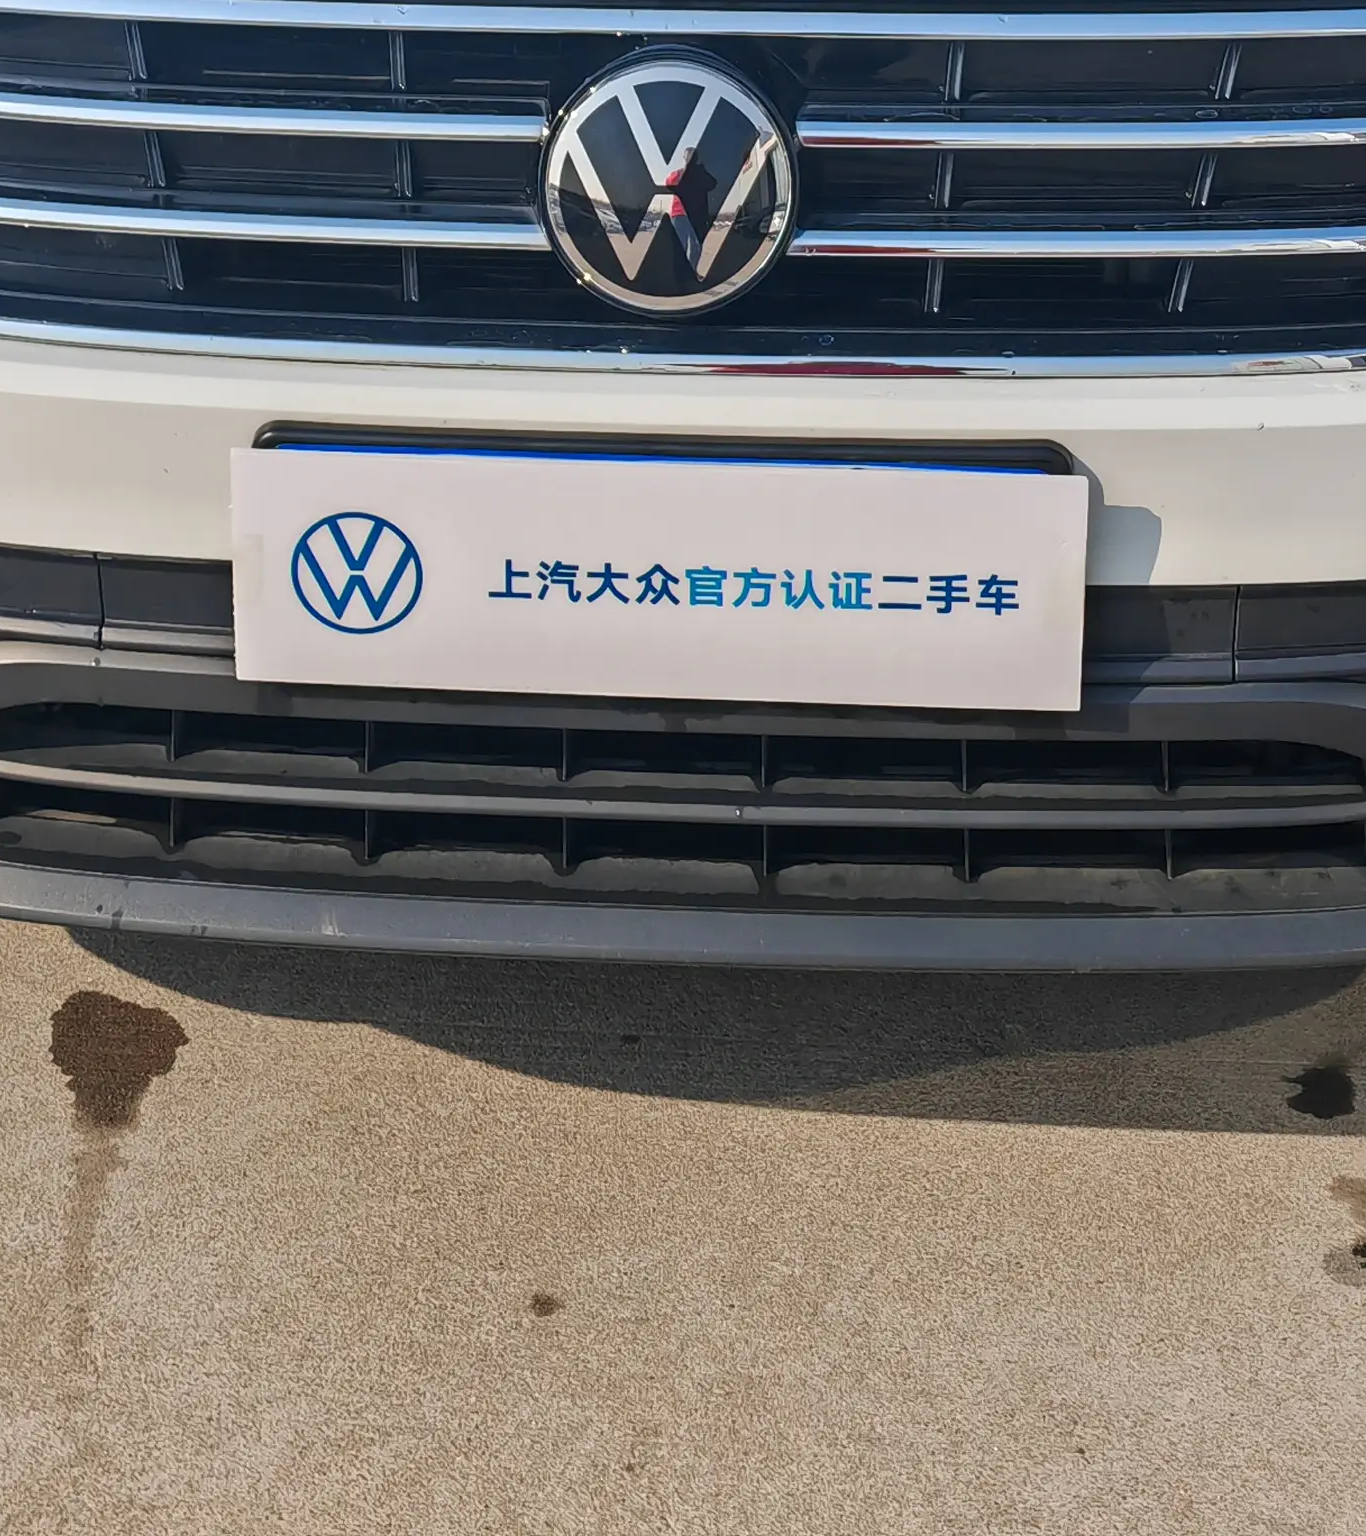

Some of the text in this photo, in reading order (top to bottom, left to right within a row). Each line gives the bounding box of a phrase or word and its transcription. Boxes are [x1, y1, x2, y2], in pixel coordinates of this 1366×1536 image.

[488, 559, 1020, 616] 上汽大众官方认证二手车
